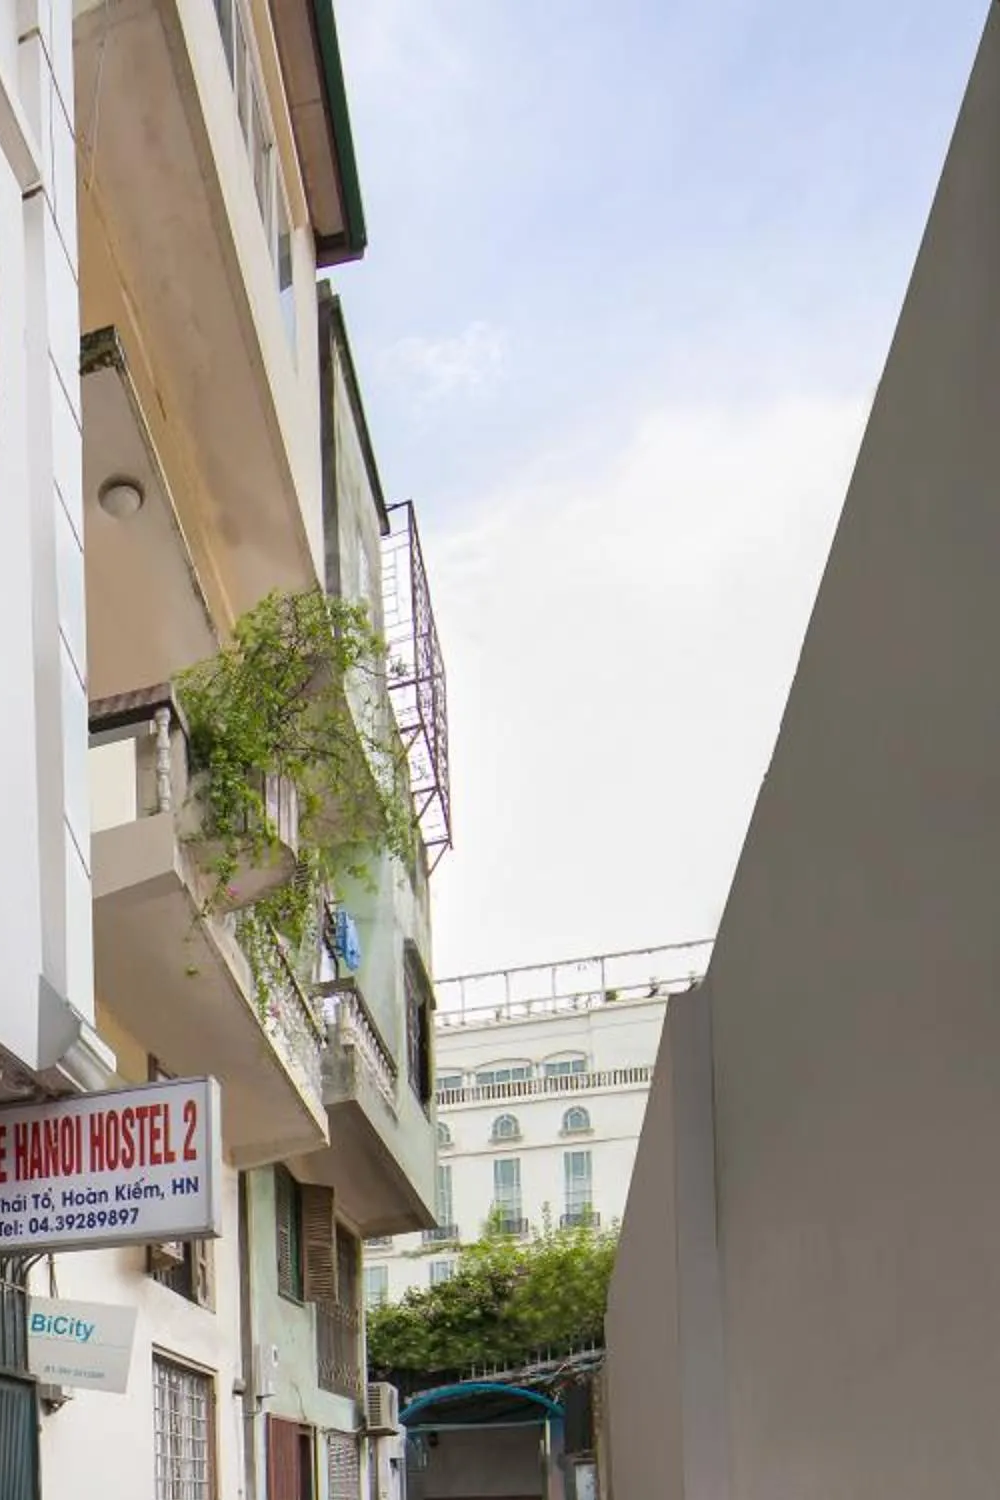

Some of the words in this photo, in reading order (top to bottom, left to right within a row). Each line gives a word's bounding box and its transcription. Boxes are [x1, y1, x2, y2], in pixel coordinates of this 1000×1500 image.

[14, 1115, 81, 1180] HANOI
[89, 1103, 175, 1173] HOSTEL
[183, 1099, 197, 1162] 2
[61, 1187, 108, 1207] Hoàn
[115, 1177, 164, 1200] Kiếm,
[172, 1176, 199, 1196] HN
[29, 1207, 139, 1235] 04.39289897
[31, 1313, 95, 1342] BiCity
